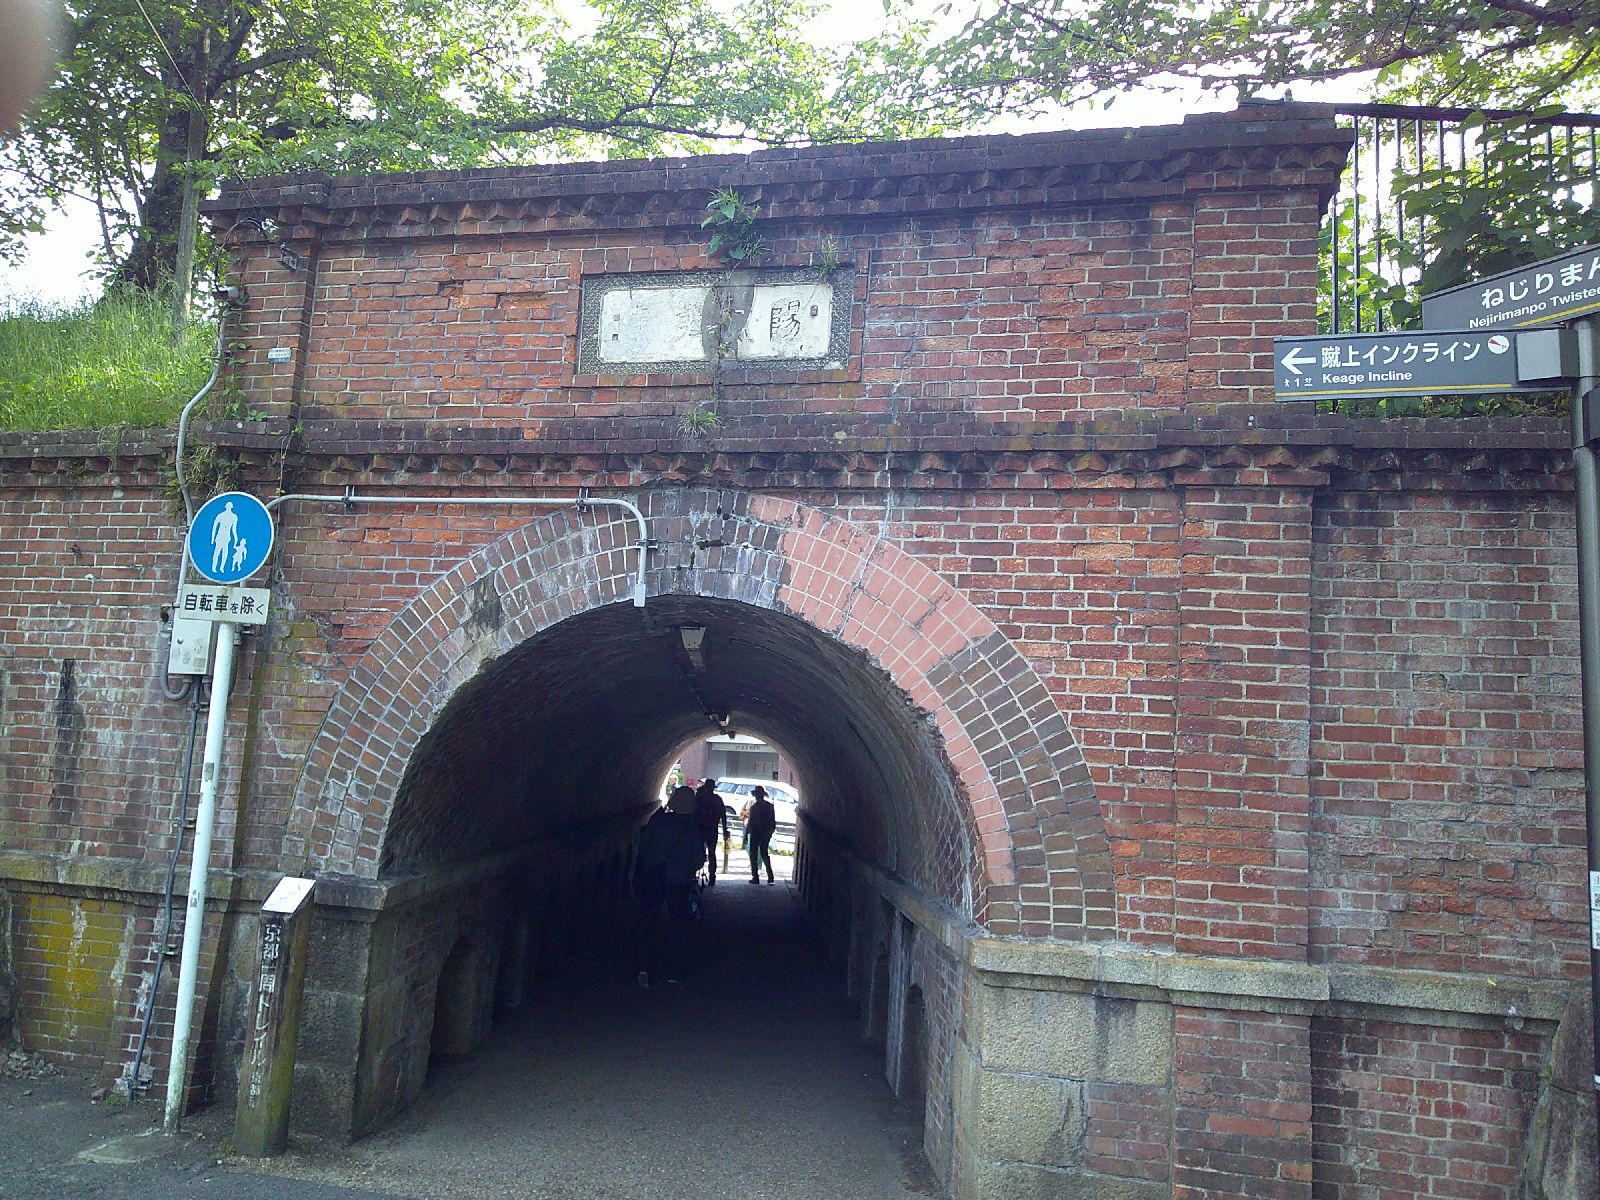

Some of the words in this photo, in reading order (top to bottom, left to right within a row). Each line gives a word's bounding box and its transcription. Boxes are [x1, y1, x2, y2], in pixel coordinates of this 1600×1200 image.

[1469, 301, 1547, 329] Nejirimanpo
[1321, 341, 1481, 369] 蹴上インクライン
[1322, 373, 1365, 385] Keage
[1368, 370, 1413, 382] Incline
[184, 592, 264, 615] 自転車を除く
